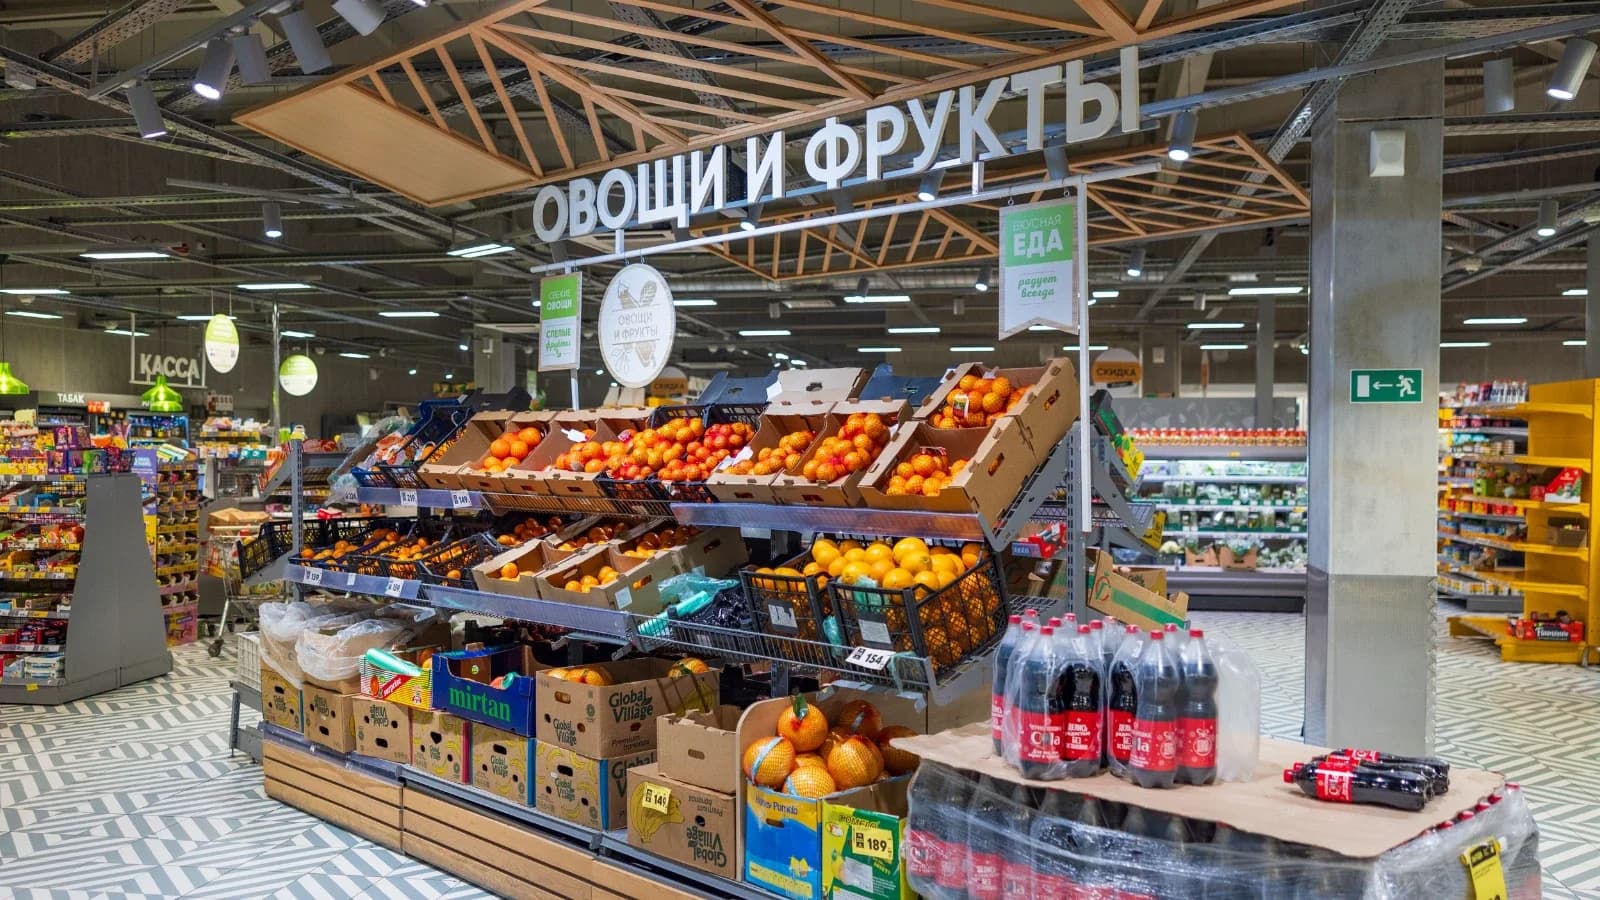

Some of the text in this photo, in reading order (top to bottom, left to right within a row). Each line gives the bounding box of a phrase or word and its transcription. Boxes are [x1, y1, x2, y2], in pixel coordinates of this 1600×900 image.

[533, 46, 1141, 242] ОВОЩИ И ФРУКТЫ
[1013, 214, 1062, 232] ВКУСНАЯ
[1013, 228, 1064, 258] ЕДА
[1018, 275, 1057, 290] радует
[1021, 288, 1055, 300] всегда
[546, 299, 573, 311] ОВОЩИ
[618, 311, 653, 326] ОВОЩИ
[622, 326, 658, 339] ФРУКТЫ
[140, 352, 200, 378] КАССА
[1096, 366, 1136, 378] СКИДКА
[57, 392, 85, 404] ТАБАК
[865, 653, 884, 665] 154
[449, 685, 511, 722] mirtan
[609, 687, 648, 708] Global
[612, 704, 654, 723] Village
[553, 718, 572, 731] Global
[556, 730, 577, 746] Village
[654, 794, 667, 807] 149
[686, 826, 724, 851] Village
[867, 838, 888, 852] 189
[693, 848, 728, 868] Global
